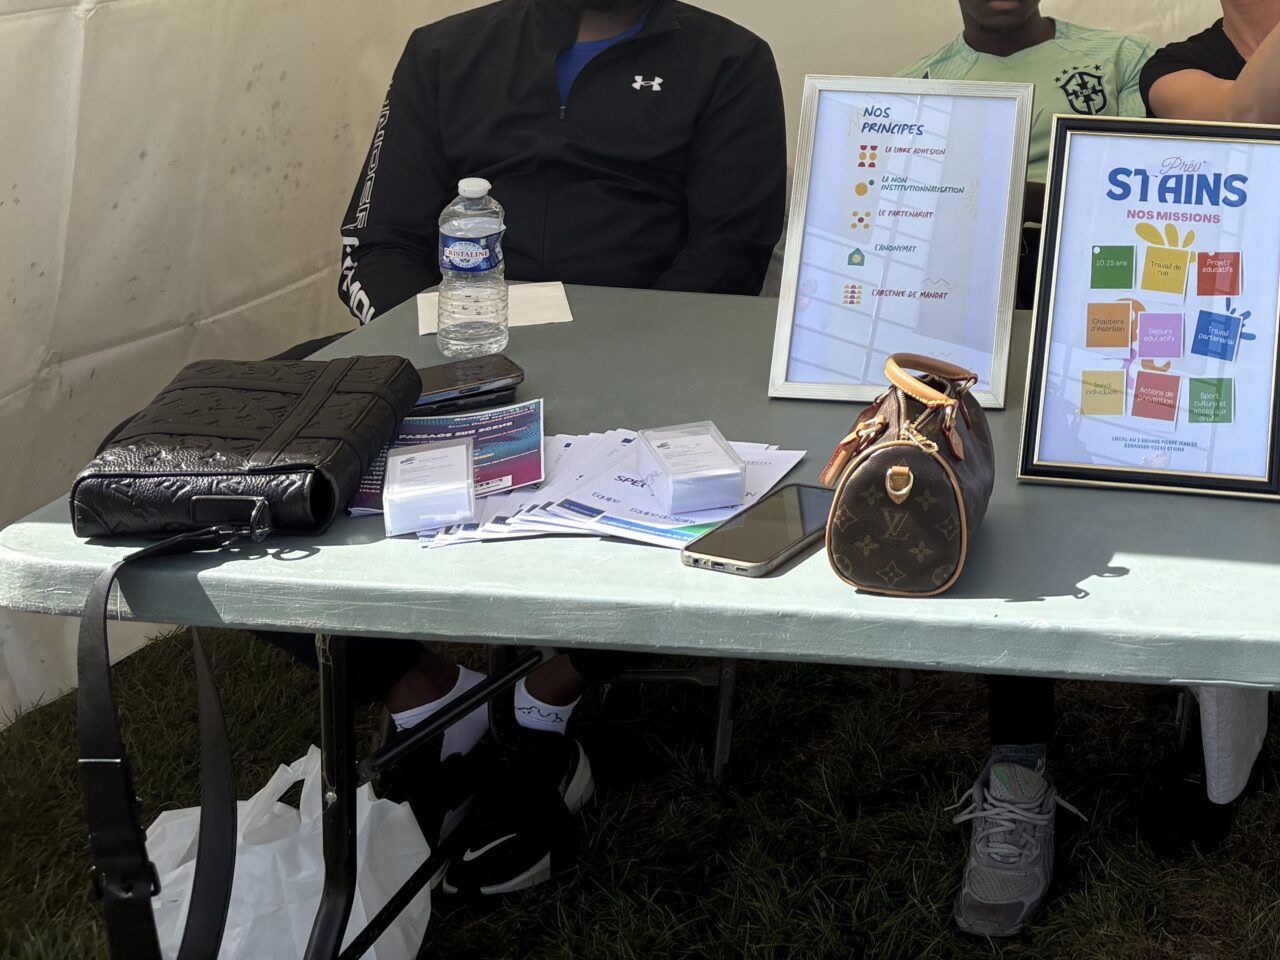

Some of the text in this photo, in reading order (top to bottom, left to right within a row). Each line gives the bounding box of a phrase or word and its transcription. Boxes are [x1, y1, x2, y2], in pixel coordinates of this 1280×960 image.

[863, 105, 891, 118] NOS
[861, 122, 924, 136] PRINCIPES
[894, 146, 911, 154] LIBRE
[890, 176, 908, 184] NON
[1106, 167, 1249, 208] STAINS
[878, 209, 934, 219] LE PARTENARIAT
[1126, 209, 1221, 224] NOS MISSIONS
[874, 244, 917, 253] L'ANONYMAT
[1151, 260, 1173, 270] Travail
[1206, 258, 1231, 267] Projets
[871, 289, 949, 300] L'ABSENCE DE MANDAT
[1091, 318, 1125, 326] Chantiers
[1091, 325, 1126, 333] d'insertion
[1139, 386, 1164, 396] Actions
[399, 432, 453, 440] PASSAGE
[454, 429, 476, 437] SUR
